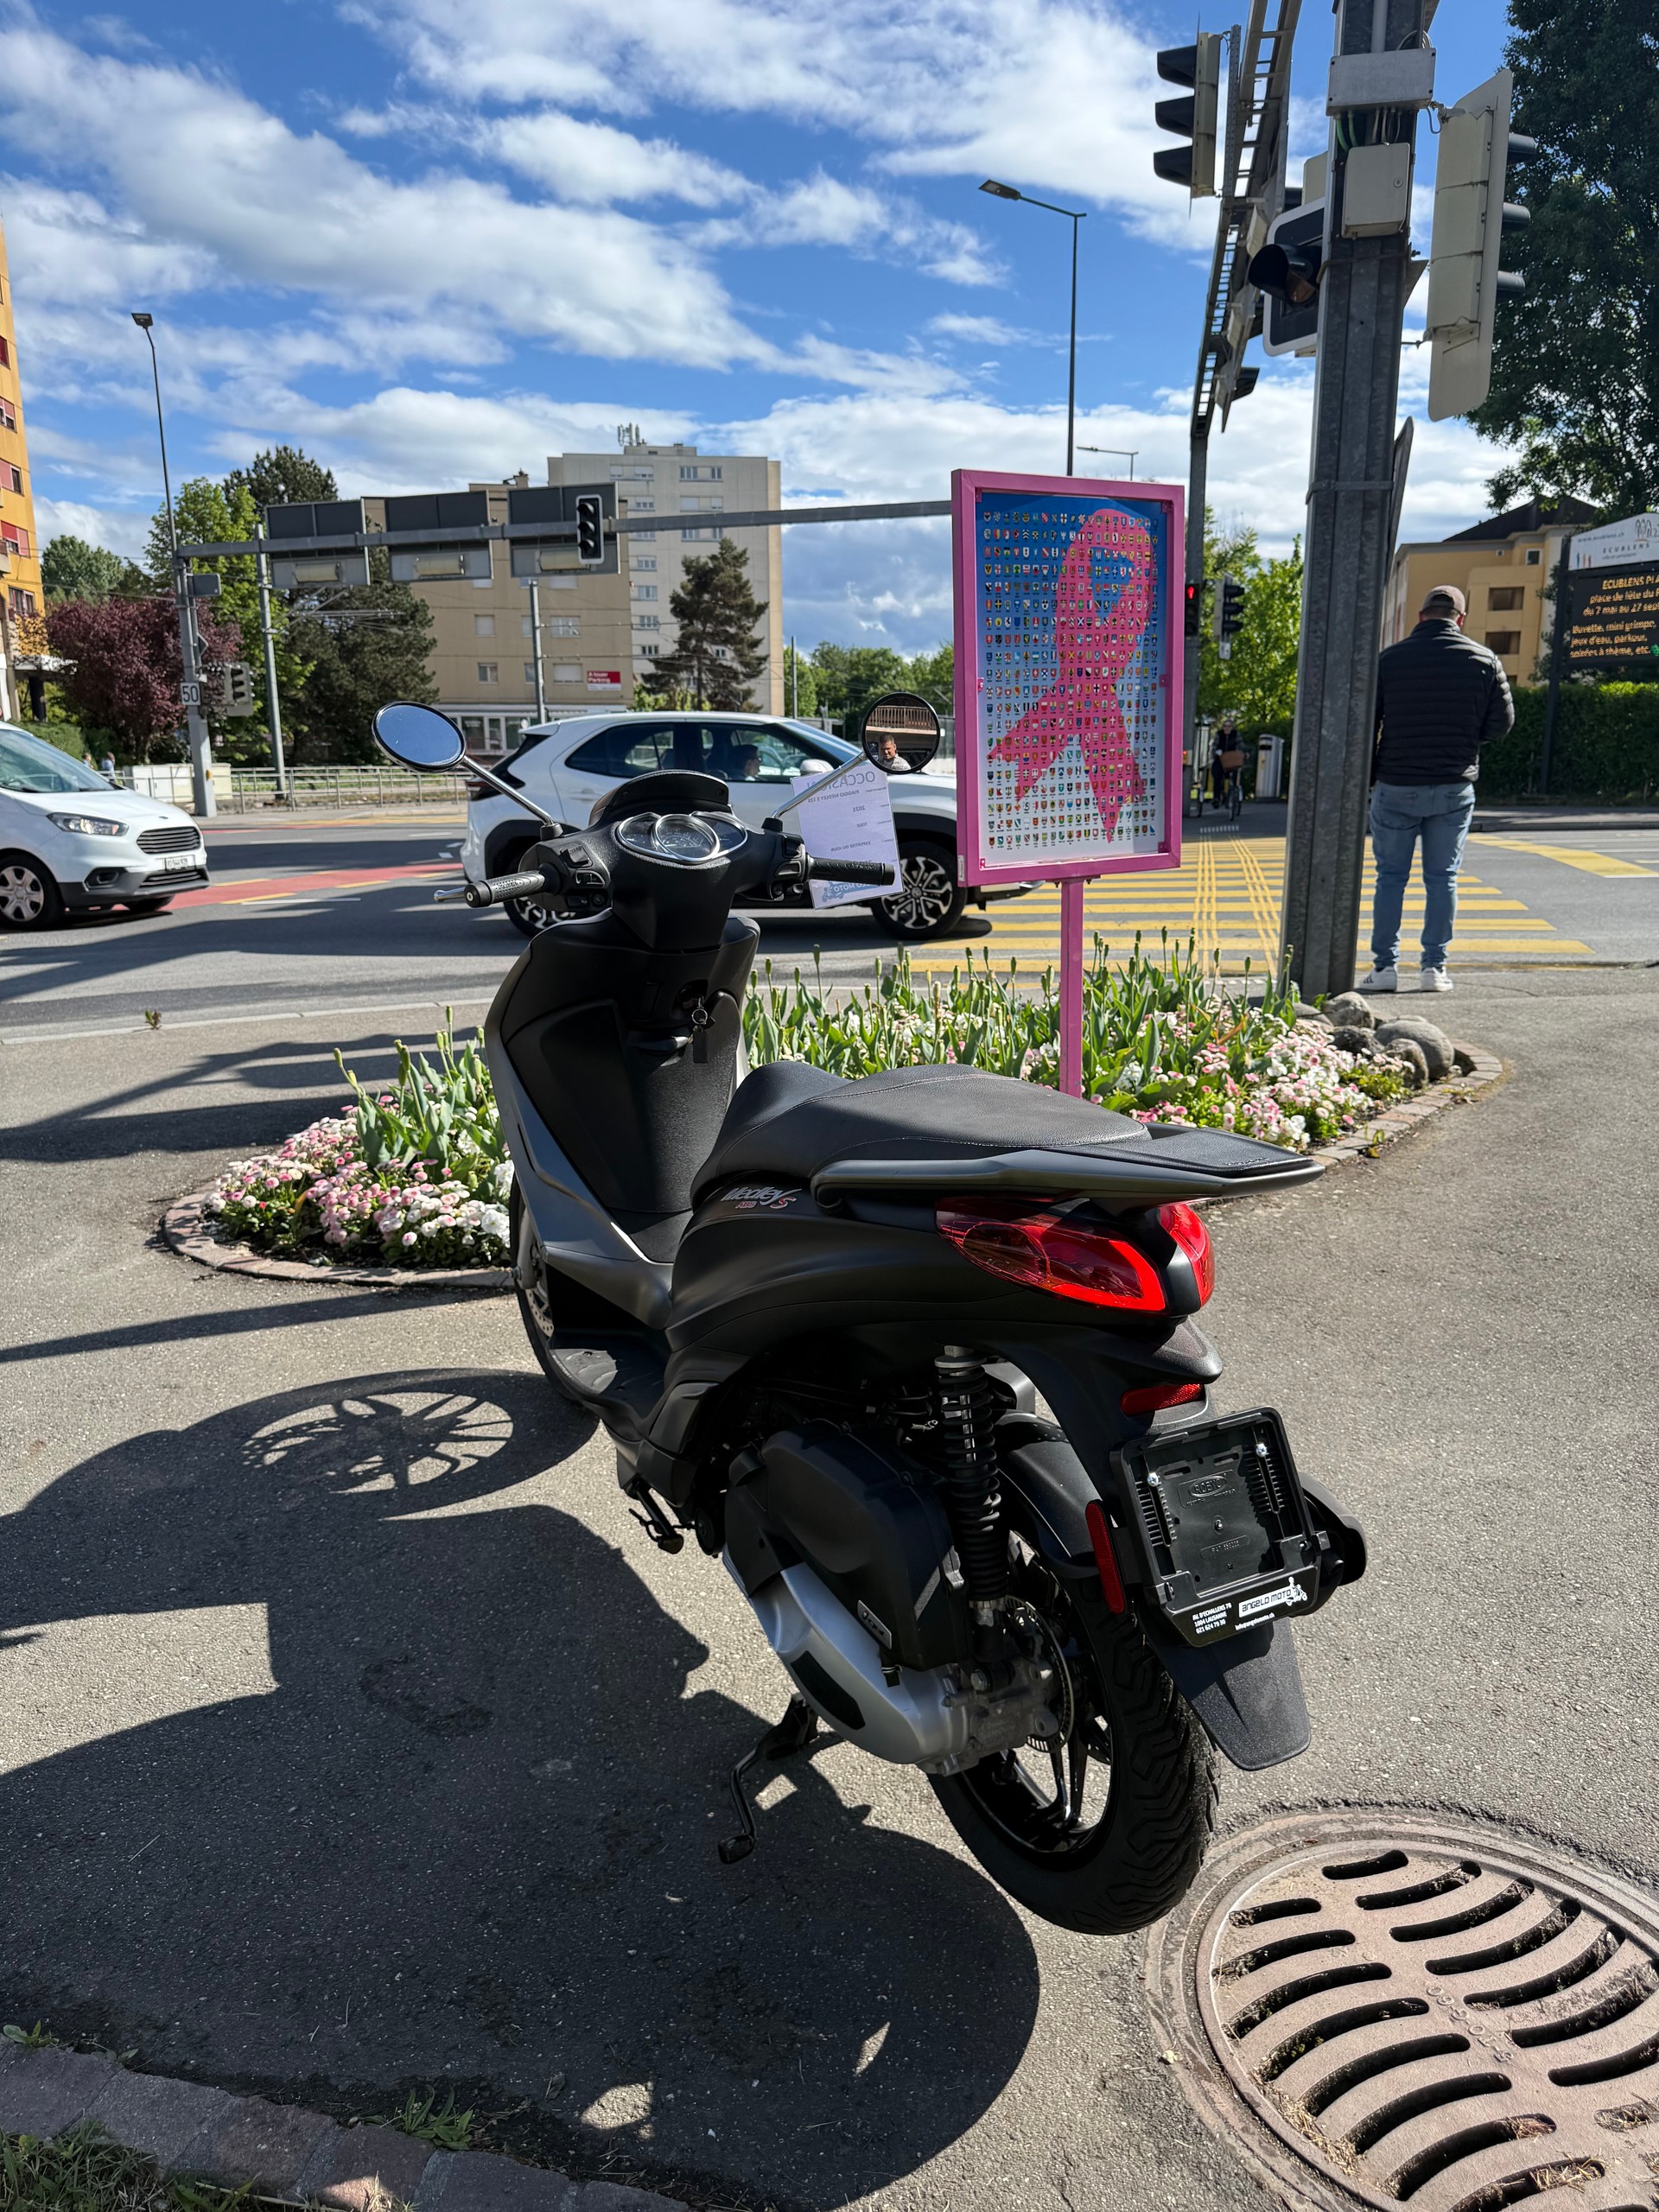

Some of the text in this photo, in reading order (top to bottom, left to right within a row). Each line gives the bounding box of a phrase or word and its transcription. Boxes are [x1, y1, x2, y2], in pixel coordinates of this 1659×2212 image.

[1603, 543, 1649, 553] ECUBLENS
[1602, 575, 1644, 590] ECUBLENS
[182, 685, 199, 702] 50
[720, 1186, 802, 1205] Medley
[735, 1200, 757, 1209] ABS
[1194, 1611, 1228, 1628] 1004 LAUSANNE
